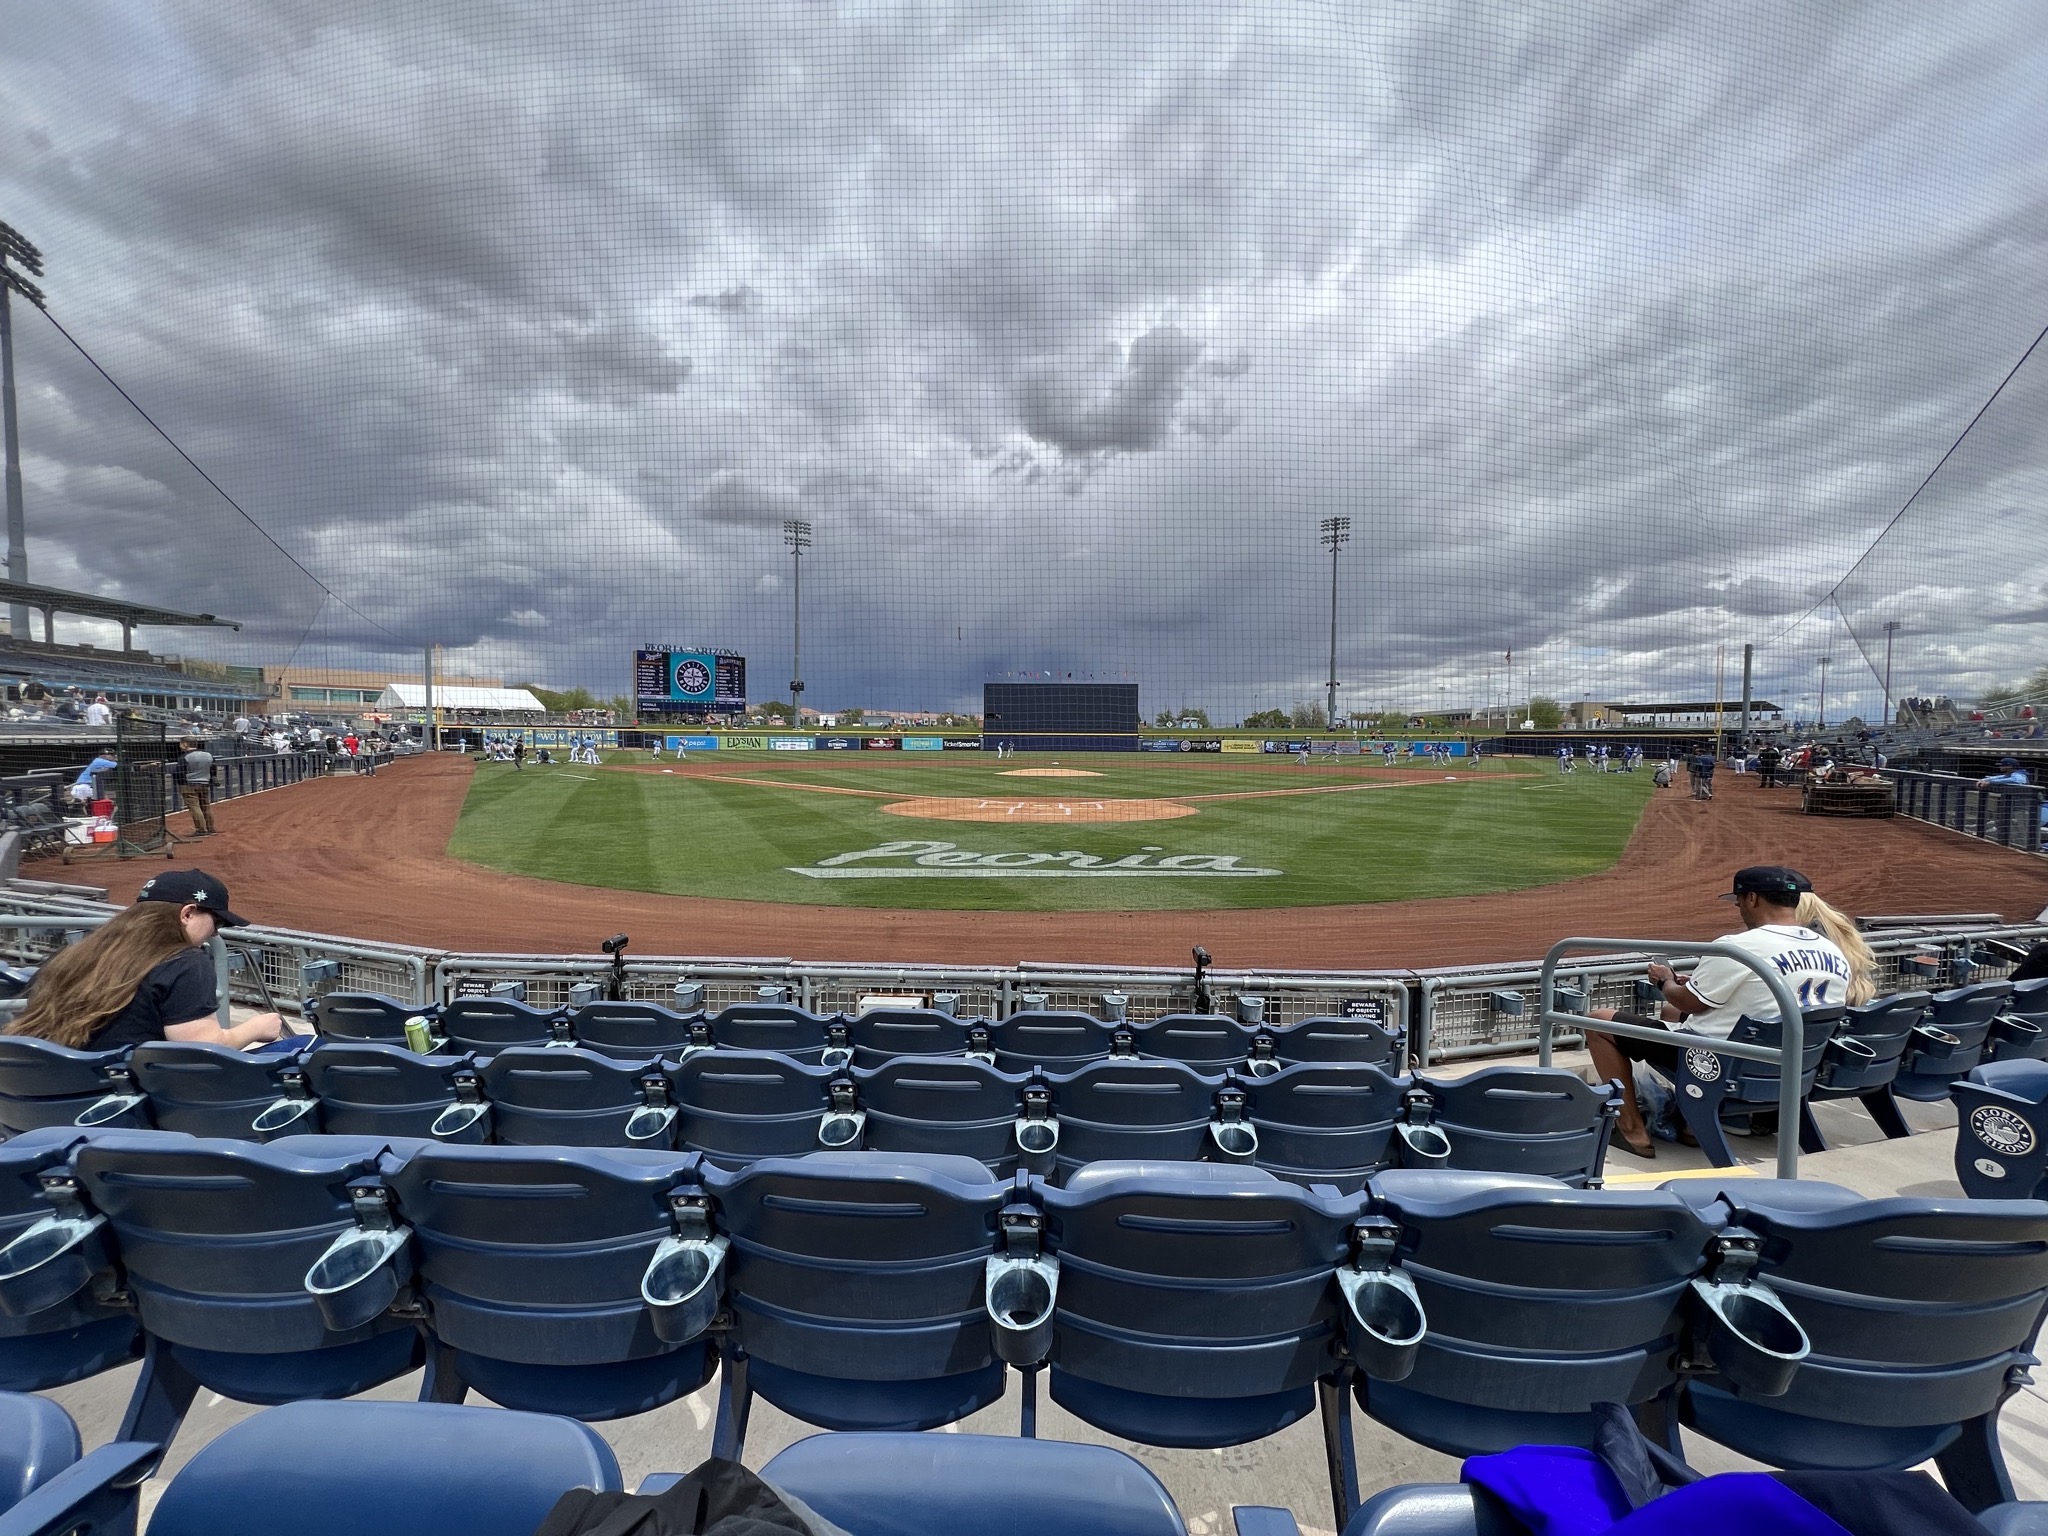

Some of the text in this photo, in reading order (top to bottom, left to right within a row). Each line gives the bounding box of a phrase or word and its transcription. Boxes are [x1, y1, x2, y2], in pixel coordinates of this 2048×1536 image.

[645, 643, 739, 657] PEORIA ARIZONA
[727, 737, 761, 748] ELYSIAN
[817, 840, 1250, 870] Peoria
[1770, 949, 1848, 982] MARTINEZ
[1797, 977, 1831, 1006] 11
[1975, 1109, 2025, 1131] PEORIA
[1976, 1129, 2030, 1153] ARIZONA
[1985, 1163, 1994, 1173] B
